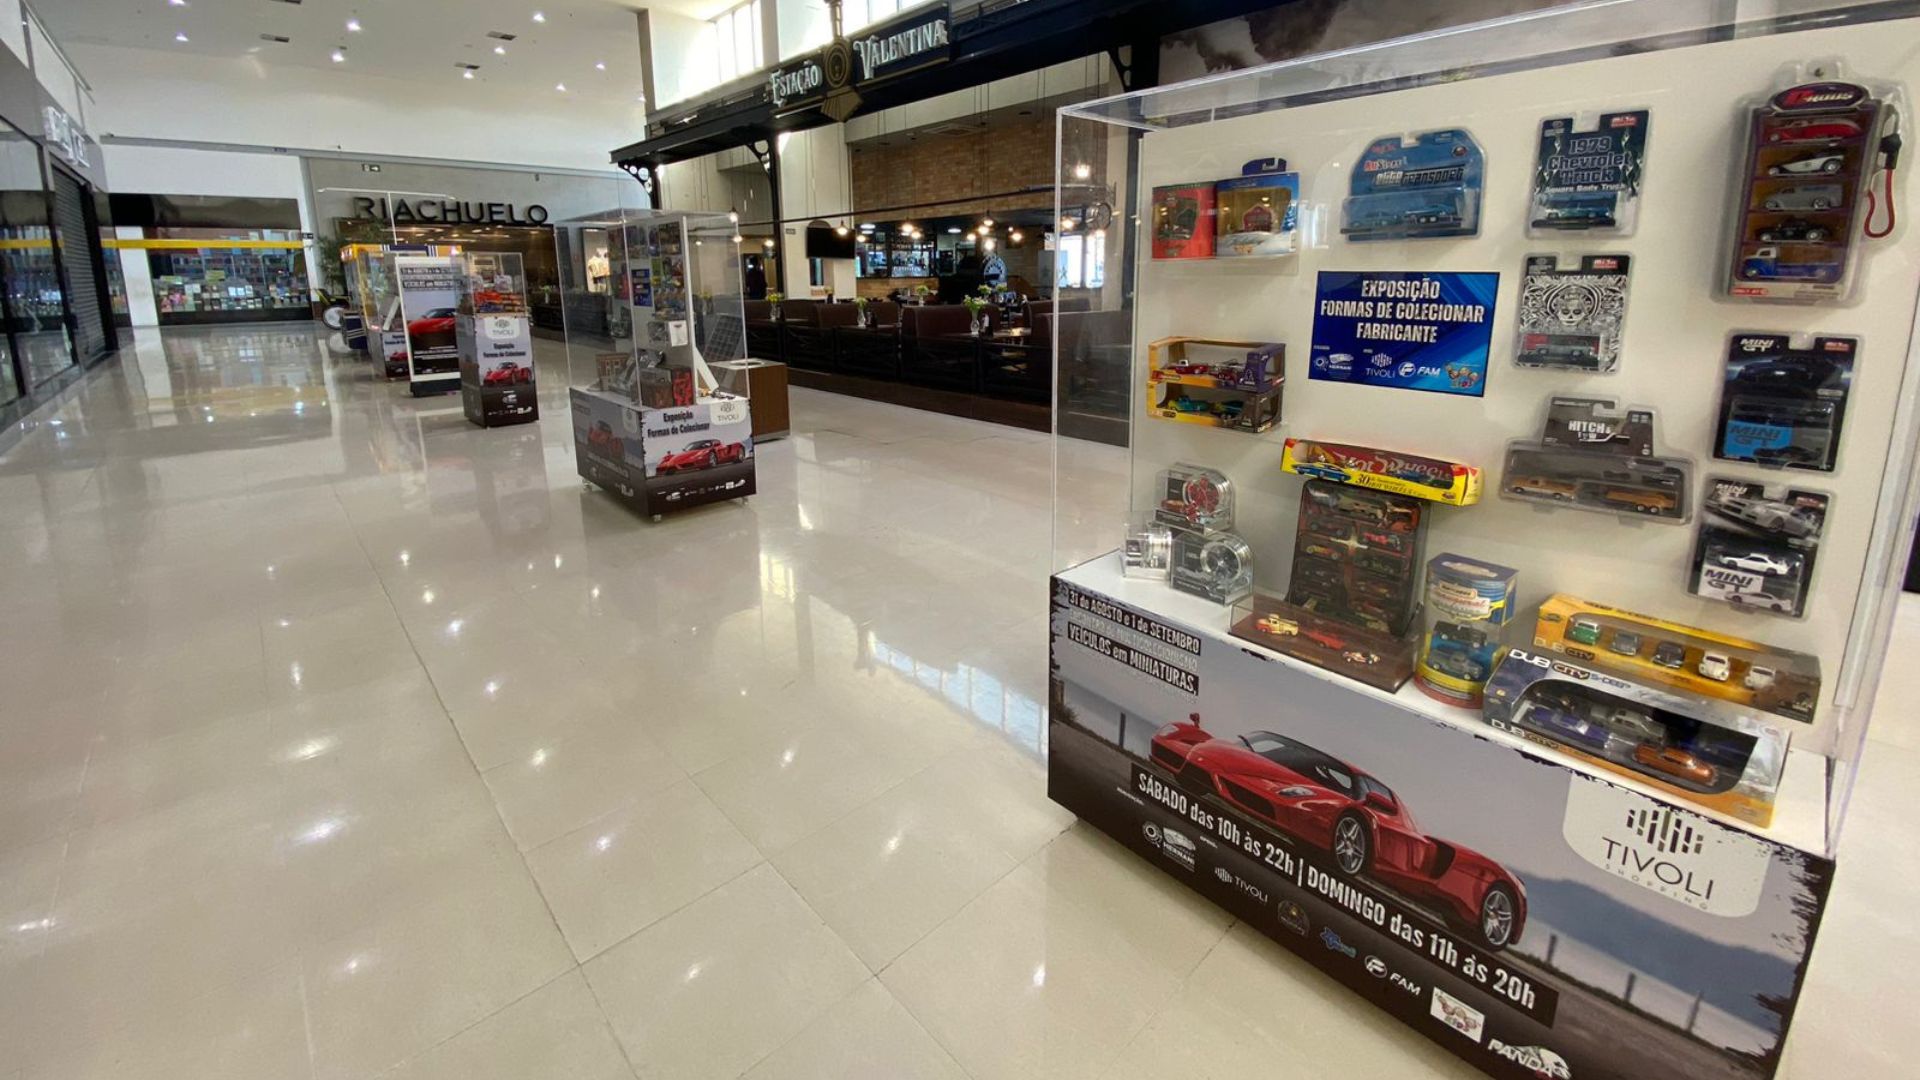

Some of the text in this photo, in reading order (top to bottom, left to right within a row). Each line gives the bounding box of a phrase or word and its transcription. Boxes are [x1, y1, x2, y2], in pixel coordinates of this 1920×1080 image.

[853, 19, 949, 80] VALENTINA
[1568, 136, 1612, 155] 1979
[1547, 151, 1632, 171] Chevrolet
[1560, 166, 1615, 185] Truck
[353, 196, 549, 225] RIACHUELO
[1361, 277, 1440, 301] EXPOSIÇÃO
[1320, 300, 1485, 323] FORMAS DE COLECIONAR
[1356, 322, 1438, 343] FABRICANTE
[1740, 338, 1774, 347] MINI
[1365, 367, 1396, 378] TIVOLI
[1416, 366, 1441, 376] FAM
[663, 411, 694, 423] Exposição
[1568, 420, 1605, 434] HITCH
[647, 423, 710, 438] Formas de Colecionar
[1730, 425, 1781, 439] MINI
[1715, 483, 1748, 494] MINI
[1704, 569, 1754, 586] MINI
[1707, 580, 1749, 593] GT
[1070, 590, 1200, 653] 31 de AGOSTO e 1 de SETEMBRO
[1112, 645, 1128, 662] em
[1129, 649, 1197, 696] MINIATURAS,
[1508, 648, 1551, 668] DUB
[1553, 663, 1590, 679] CITY
[1601, 836, 1714, 900] TIVOLI
[1138, 772, 1187, 815] SÁBADO
[1190, 802, 1214, 830] das
[1217, 816, 1240, 846] 10h
[1244, 830, 1261, 857] às
[1264, 843, 1294, 876] 22h
[1307, 867, 1386, 926] DOMINGO
[1390, 914, 1424, 947] das
[1429, 933, 1458, 967] 11h
[1462, 953, 1488, 984] às
[1492, 969, 1536, 1010] 20h
[1234, 875, 1268, 903] TIVOLI
[1389, 972, 1421, 996] FAM
